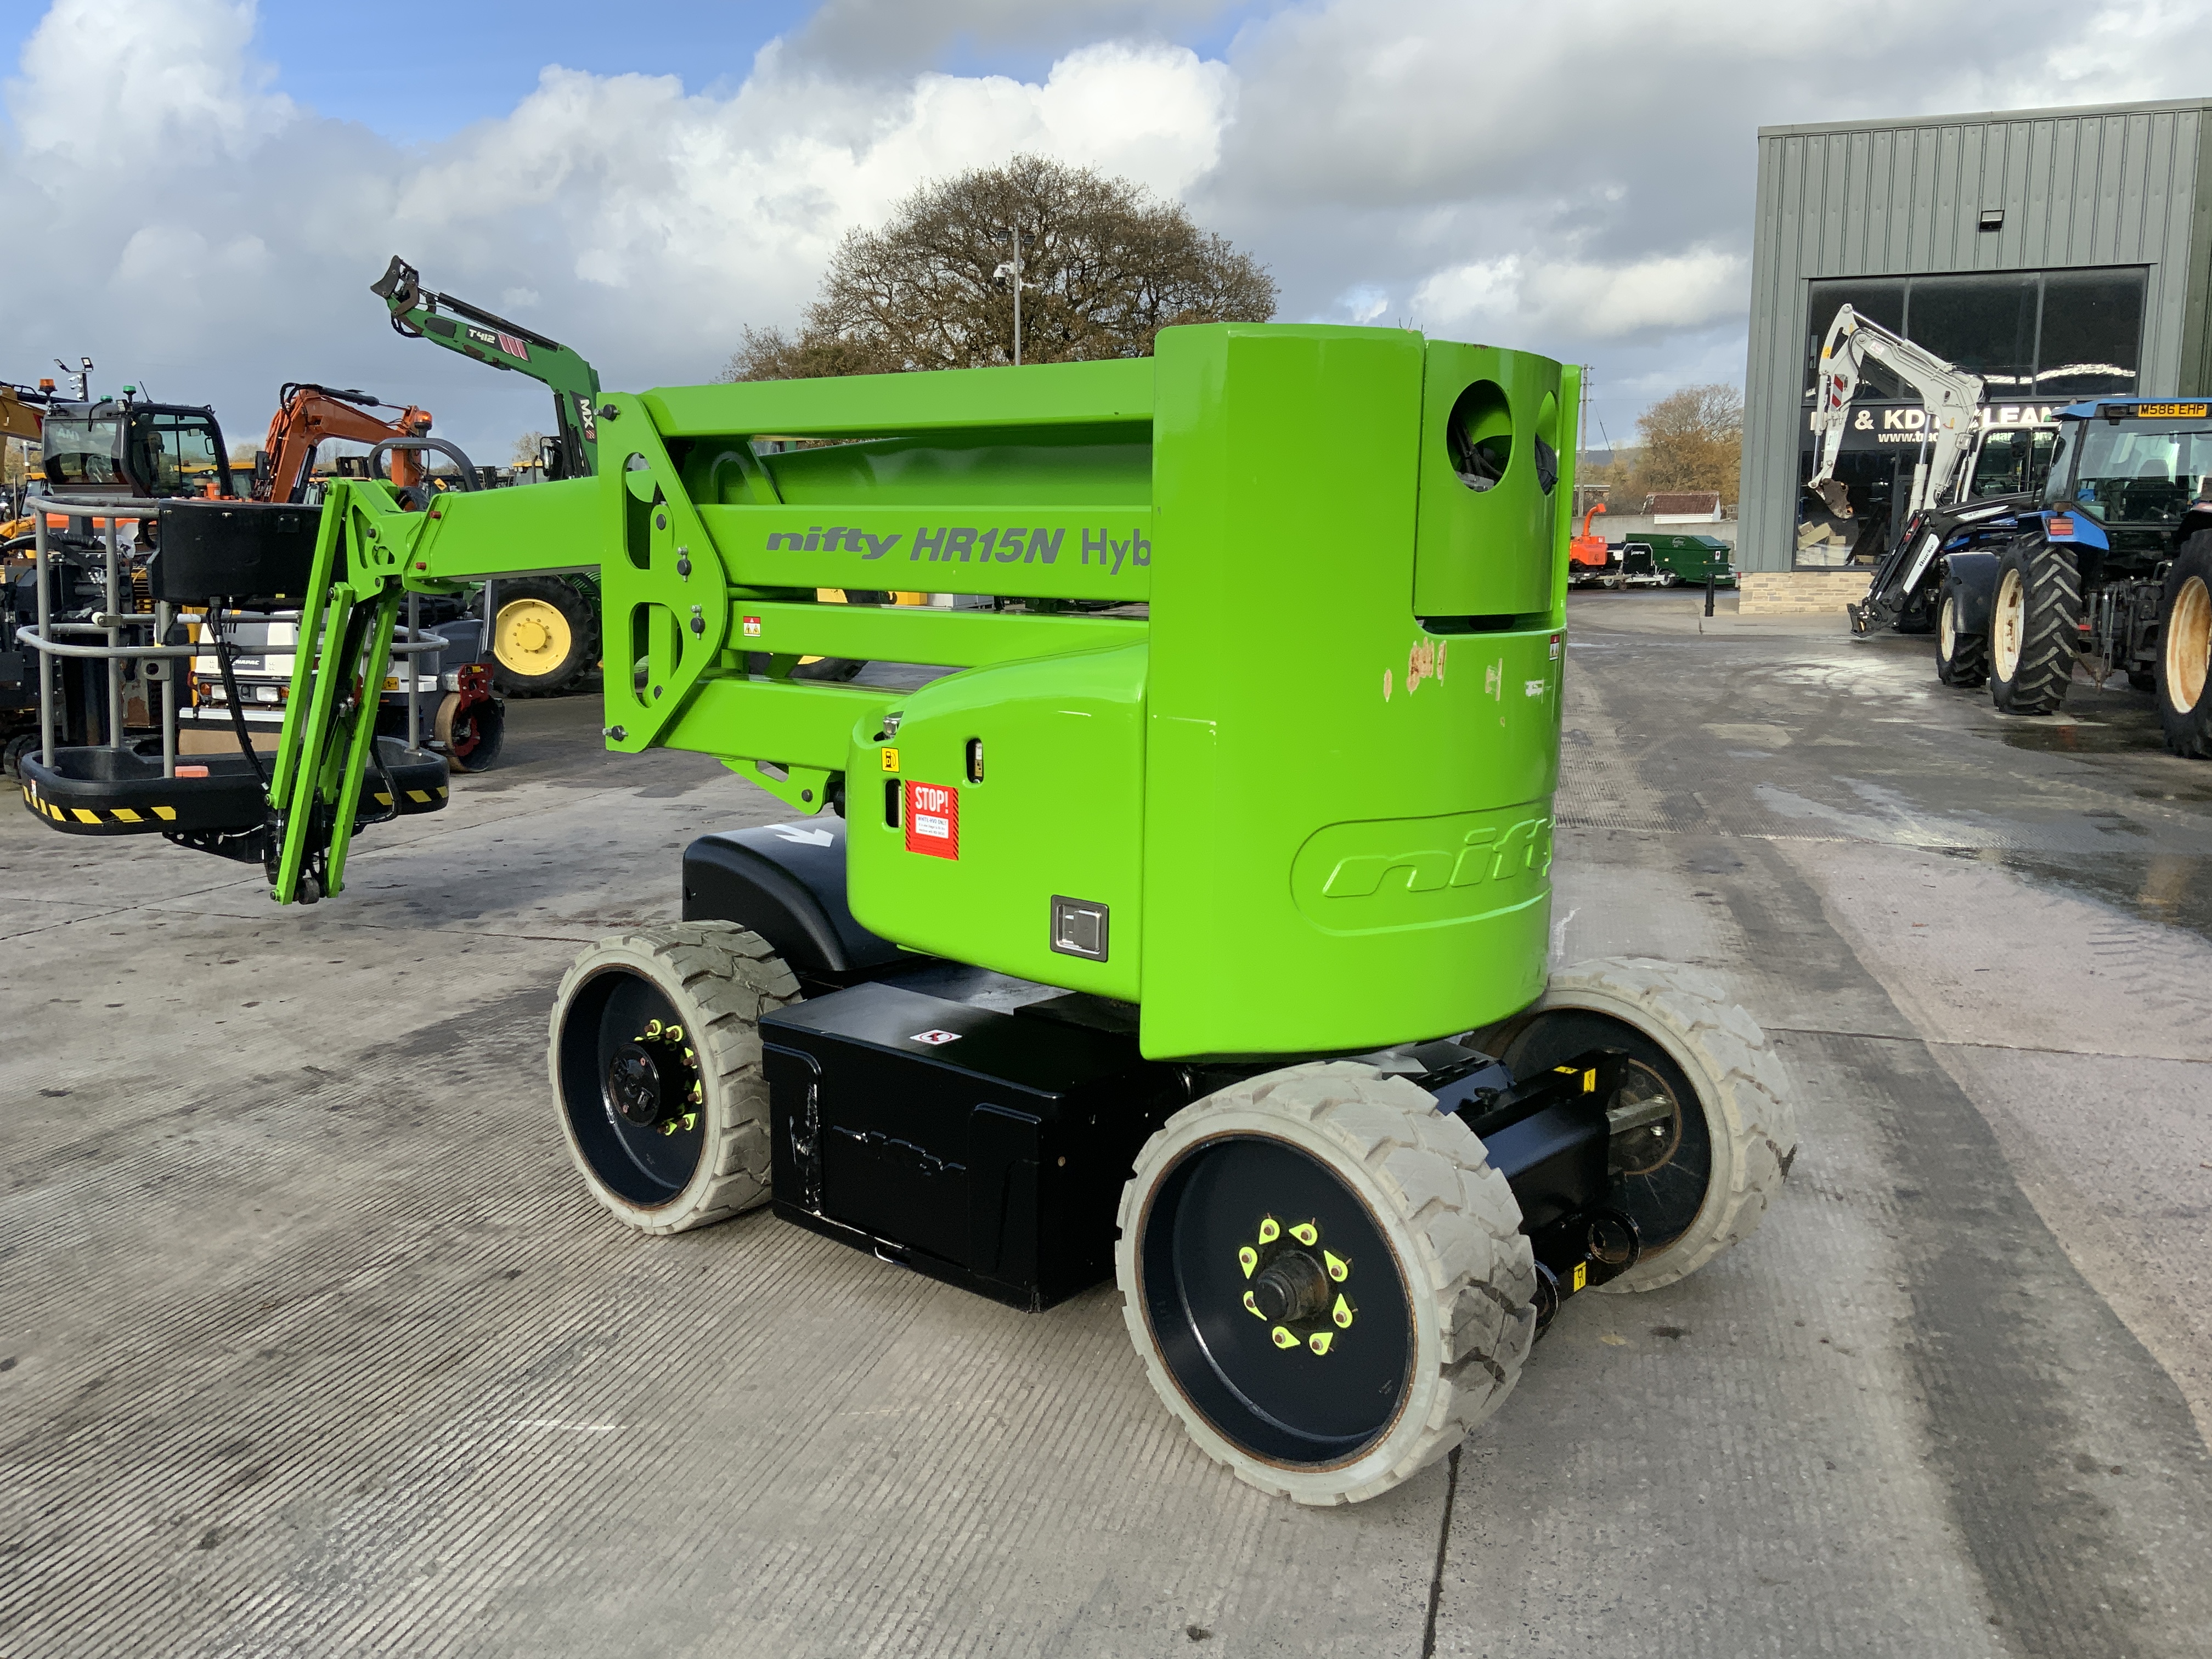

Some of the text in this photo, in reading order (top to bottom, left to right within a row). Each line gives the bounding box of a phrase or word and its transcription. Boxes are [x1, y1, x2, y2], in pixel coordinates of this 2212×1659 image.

[469, 329, 496, 344] T412
[580, 399, 594, 429] MX
[1854, 410, 1875, 430] &
[1884, 409, 1926, 430] KD
[2140, 404, 2205, 415] M586 EHP
[766, 526, 903, 560] nifty
[909, 527, 1066, 565] HR15N
[915, 786, 949, 814] STOP!
[1322, 816, 1556, 898] nift
